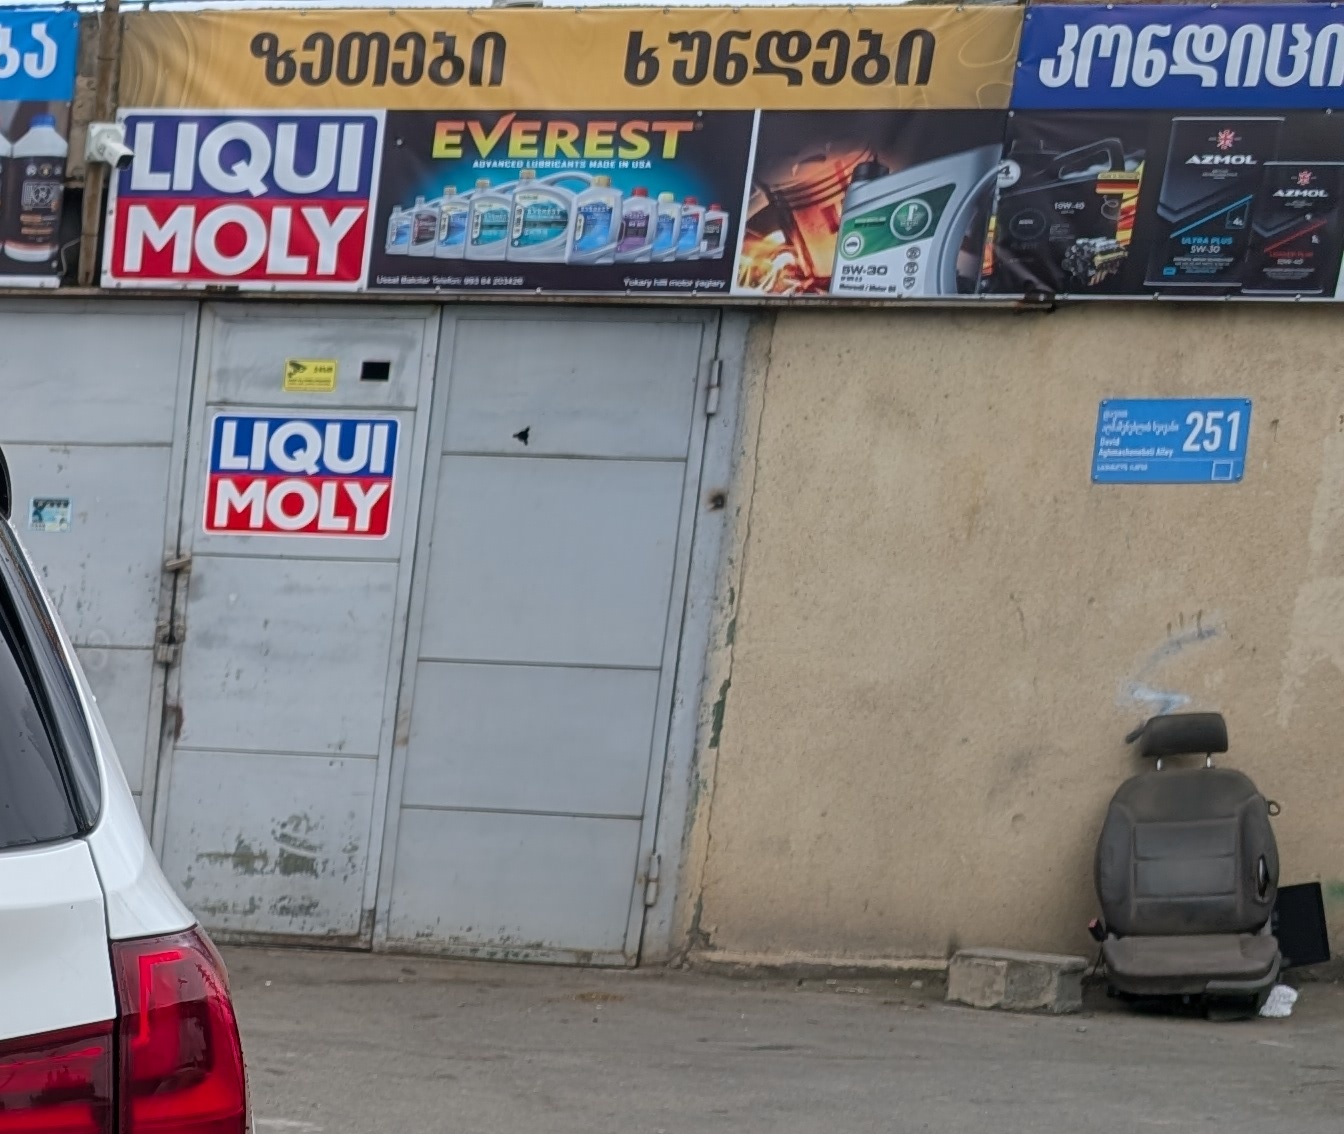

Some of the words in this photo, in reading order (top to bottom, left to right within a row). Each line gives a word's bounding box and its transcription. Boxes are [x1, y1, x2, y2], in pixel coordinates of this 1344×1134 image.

[249, 31, 507, 87] ზეთები
[623, 28, 936, 87] ხუნდები
[130, 120, 365, 197] LIQUI
[431, 112, 694, 159] EVEREST
[472, 160, 524, 169] ADVANCED
[526, 160, 586, 169] LUBRICANTS
[589, 160, 616, 169] MADE
[618, 160, 629, 169] IN
[631, 160, 652, 169] USA
[1184, 154, 1257, 165] AZMOL
[1272, 189, 1329, 198] AZMOL
[123, 204, 365, 276] MOLY
[841, 265, 888, 276] 5W-30
[219, 419, 391, 475] LIQUI
[1182, 410, 1241, 453] 251
[213, 478, 390, 533] MOLY
